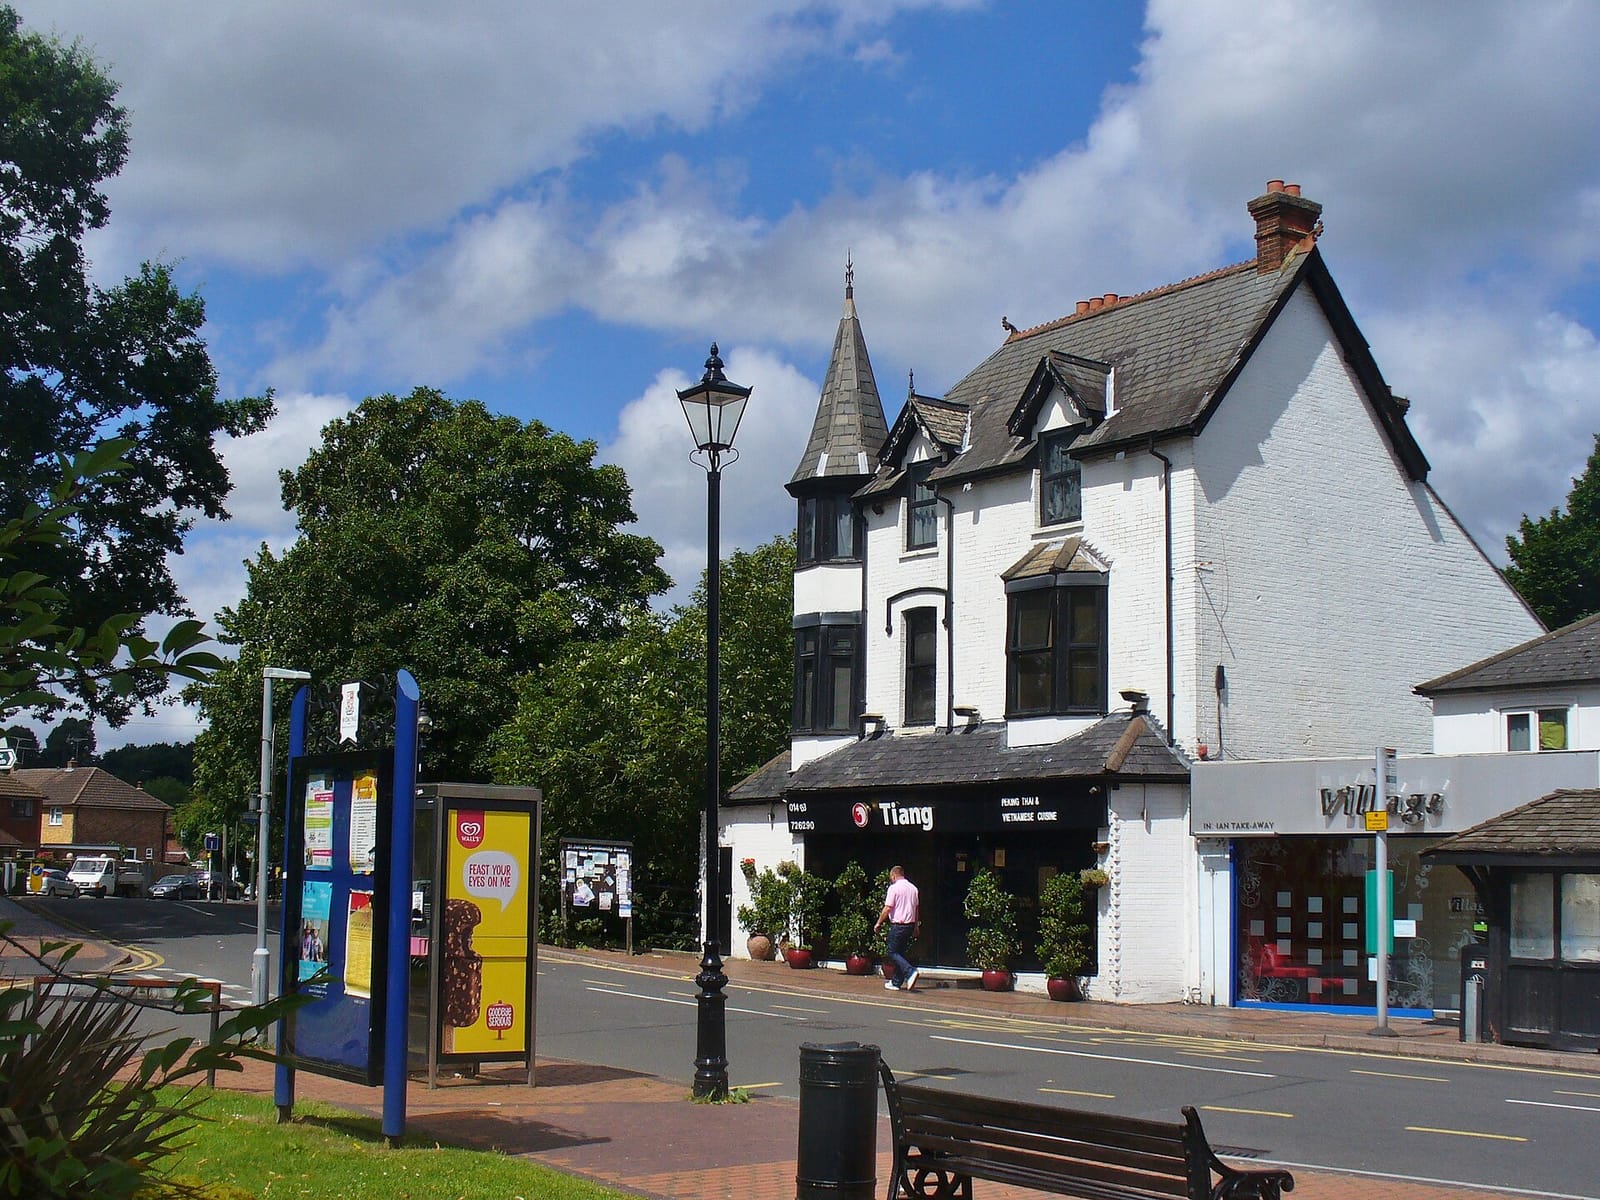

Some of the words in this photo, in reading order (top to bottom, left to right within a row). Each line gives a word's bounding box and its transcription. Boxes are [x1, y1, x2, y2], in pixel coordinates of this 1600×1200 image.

[1021, 796, 1034, 806] THAI
[1035, 796, 1040, 806] &
[878, 801, 934, 831] Tiang
[1002, 812, 1035, 823] VIETNAMESE
[1037, 811, 1058, 821] CUISINE
[790, 820, 815, 830] 726290
[1231, 820, 1275, 830] TAKE-AWAY
[469, 863, 490, 875] FEAST
[491, 864, 512, 876] YOUR
[468, 875, 486, 888] EYES
[487, 876, 498, 887] ON
[500, 876, 511, 888] ME
[1447, 897, 1485, 914] Villag
